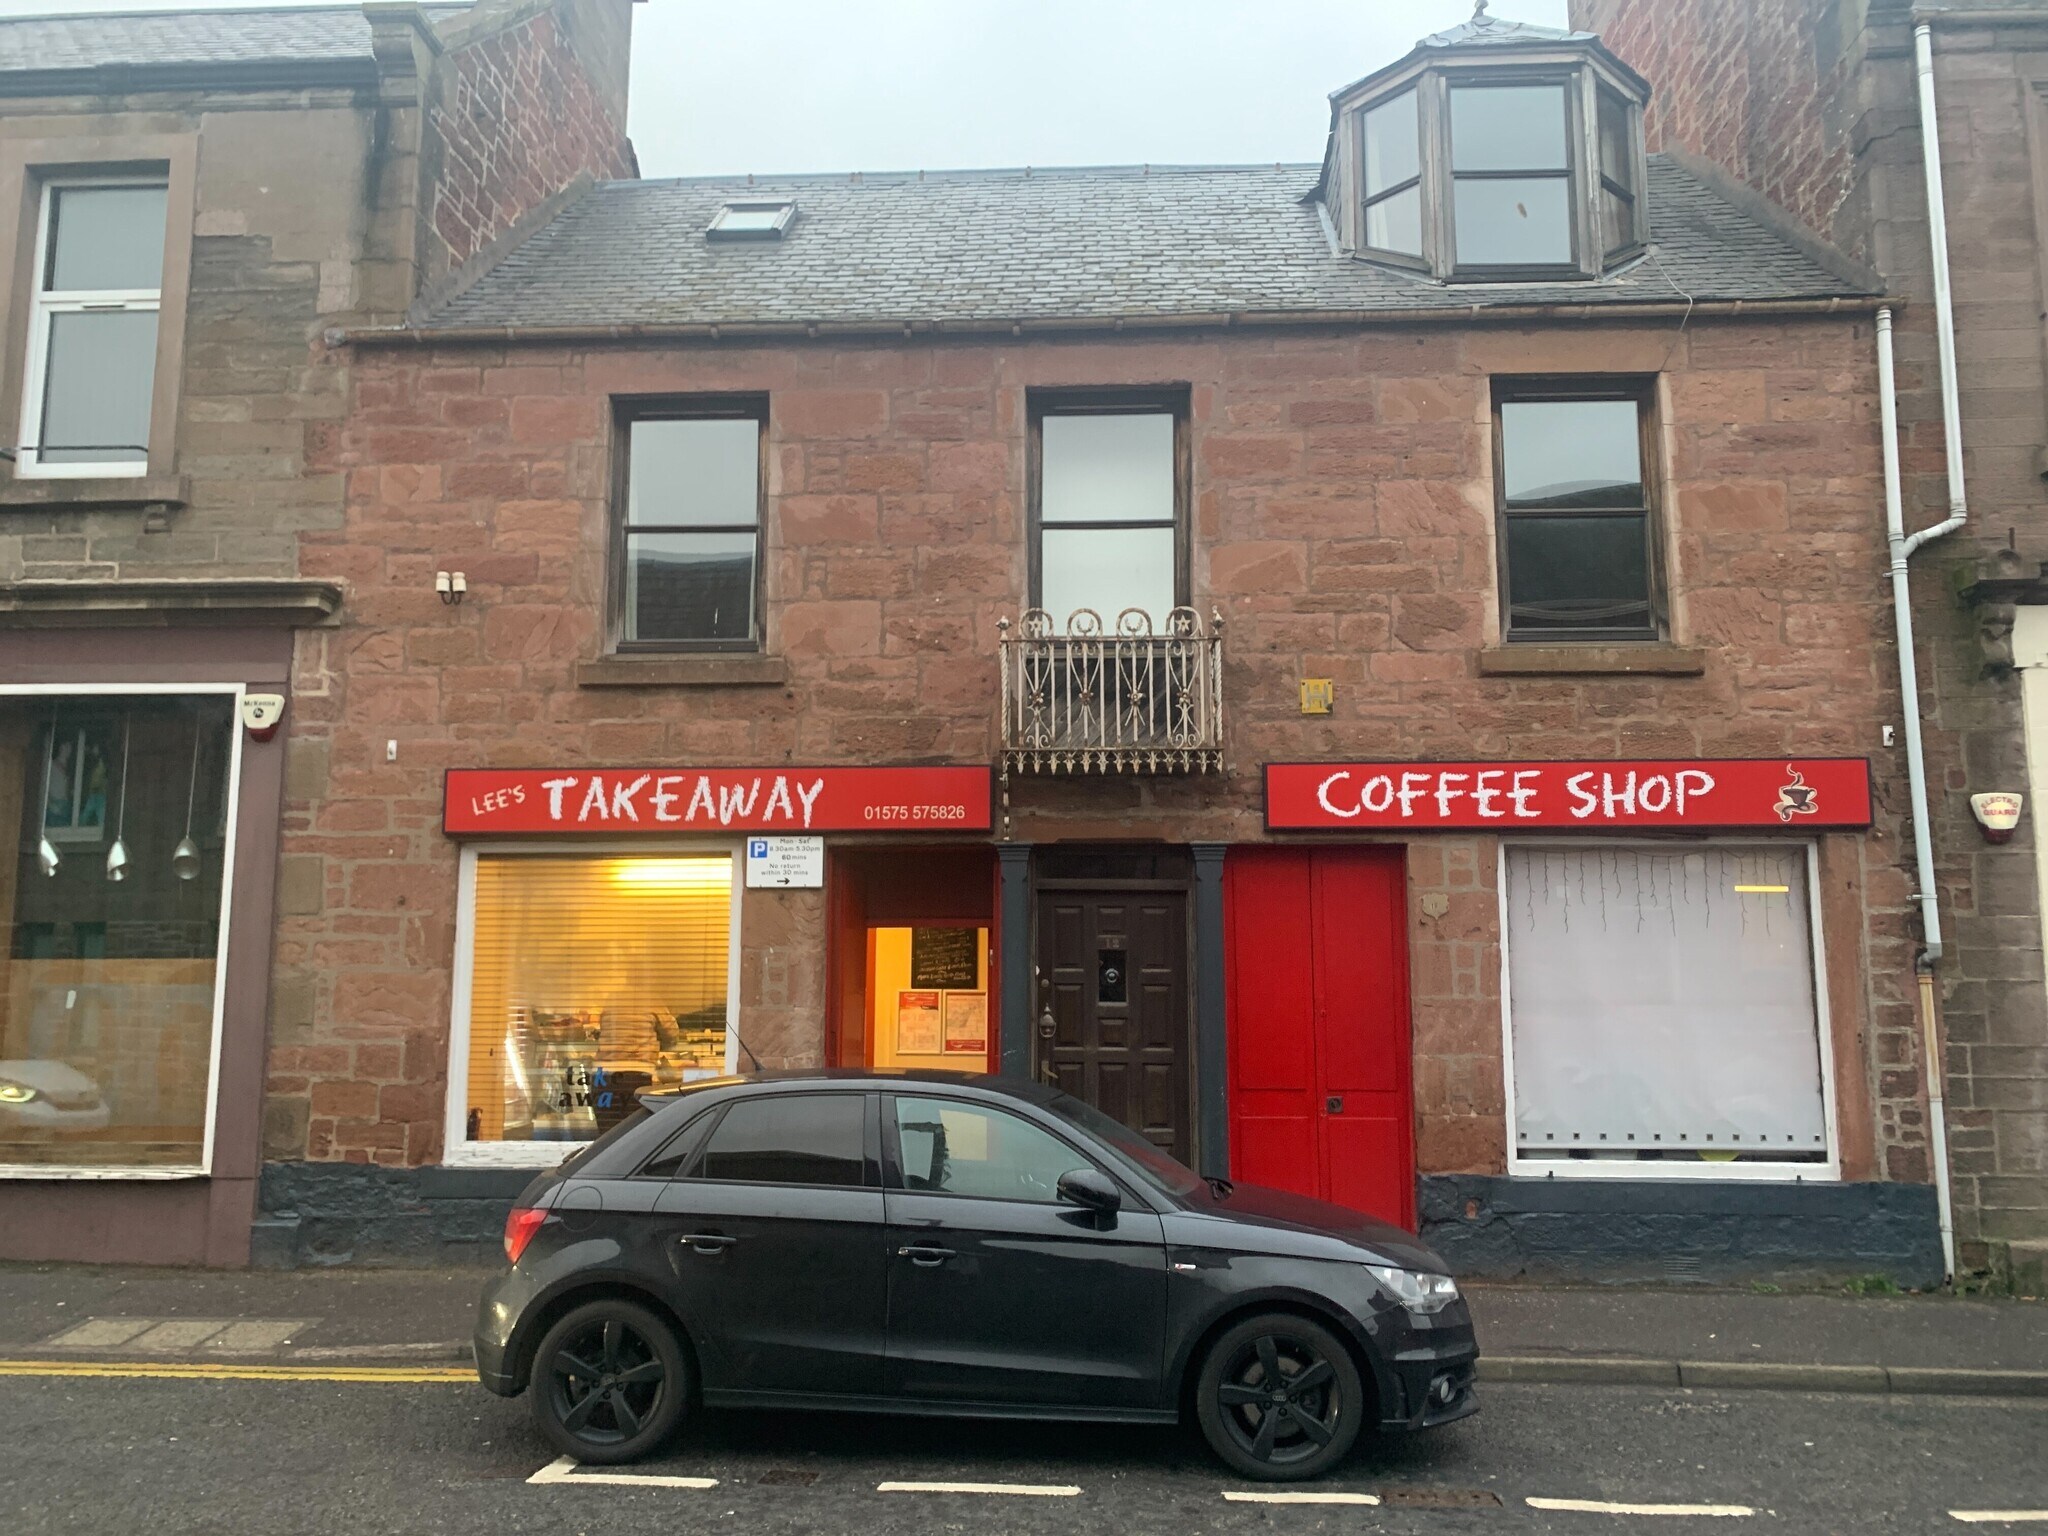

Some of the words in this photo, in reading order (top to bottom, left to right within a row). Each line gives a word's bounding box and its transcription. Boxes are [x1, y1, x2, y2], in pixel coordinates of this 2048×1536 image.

[471, 785, 526, 817] LEE'S
[542, 774, 824, 829] TAKEAWAY
[1316, 770, 1543, 818] COFFEE
[1566, 769, 1716, 819] SHOP
[1980, 796, 2019, 809] ELECTRO
[864, 805, 909, 820] 01575
[912, 804, 966, 820] 575826
[754, 842, 766, 858] P
